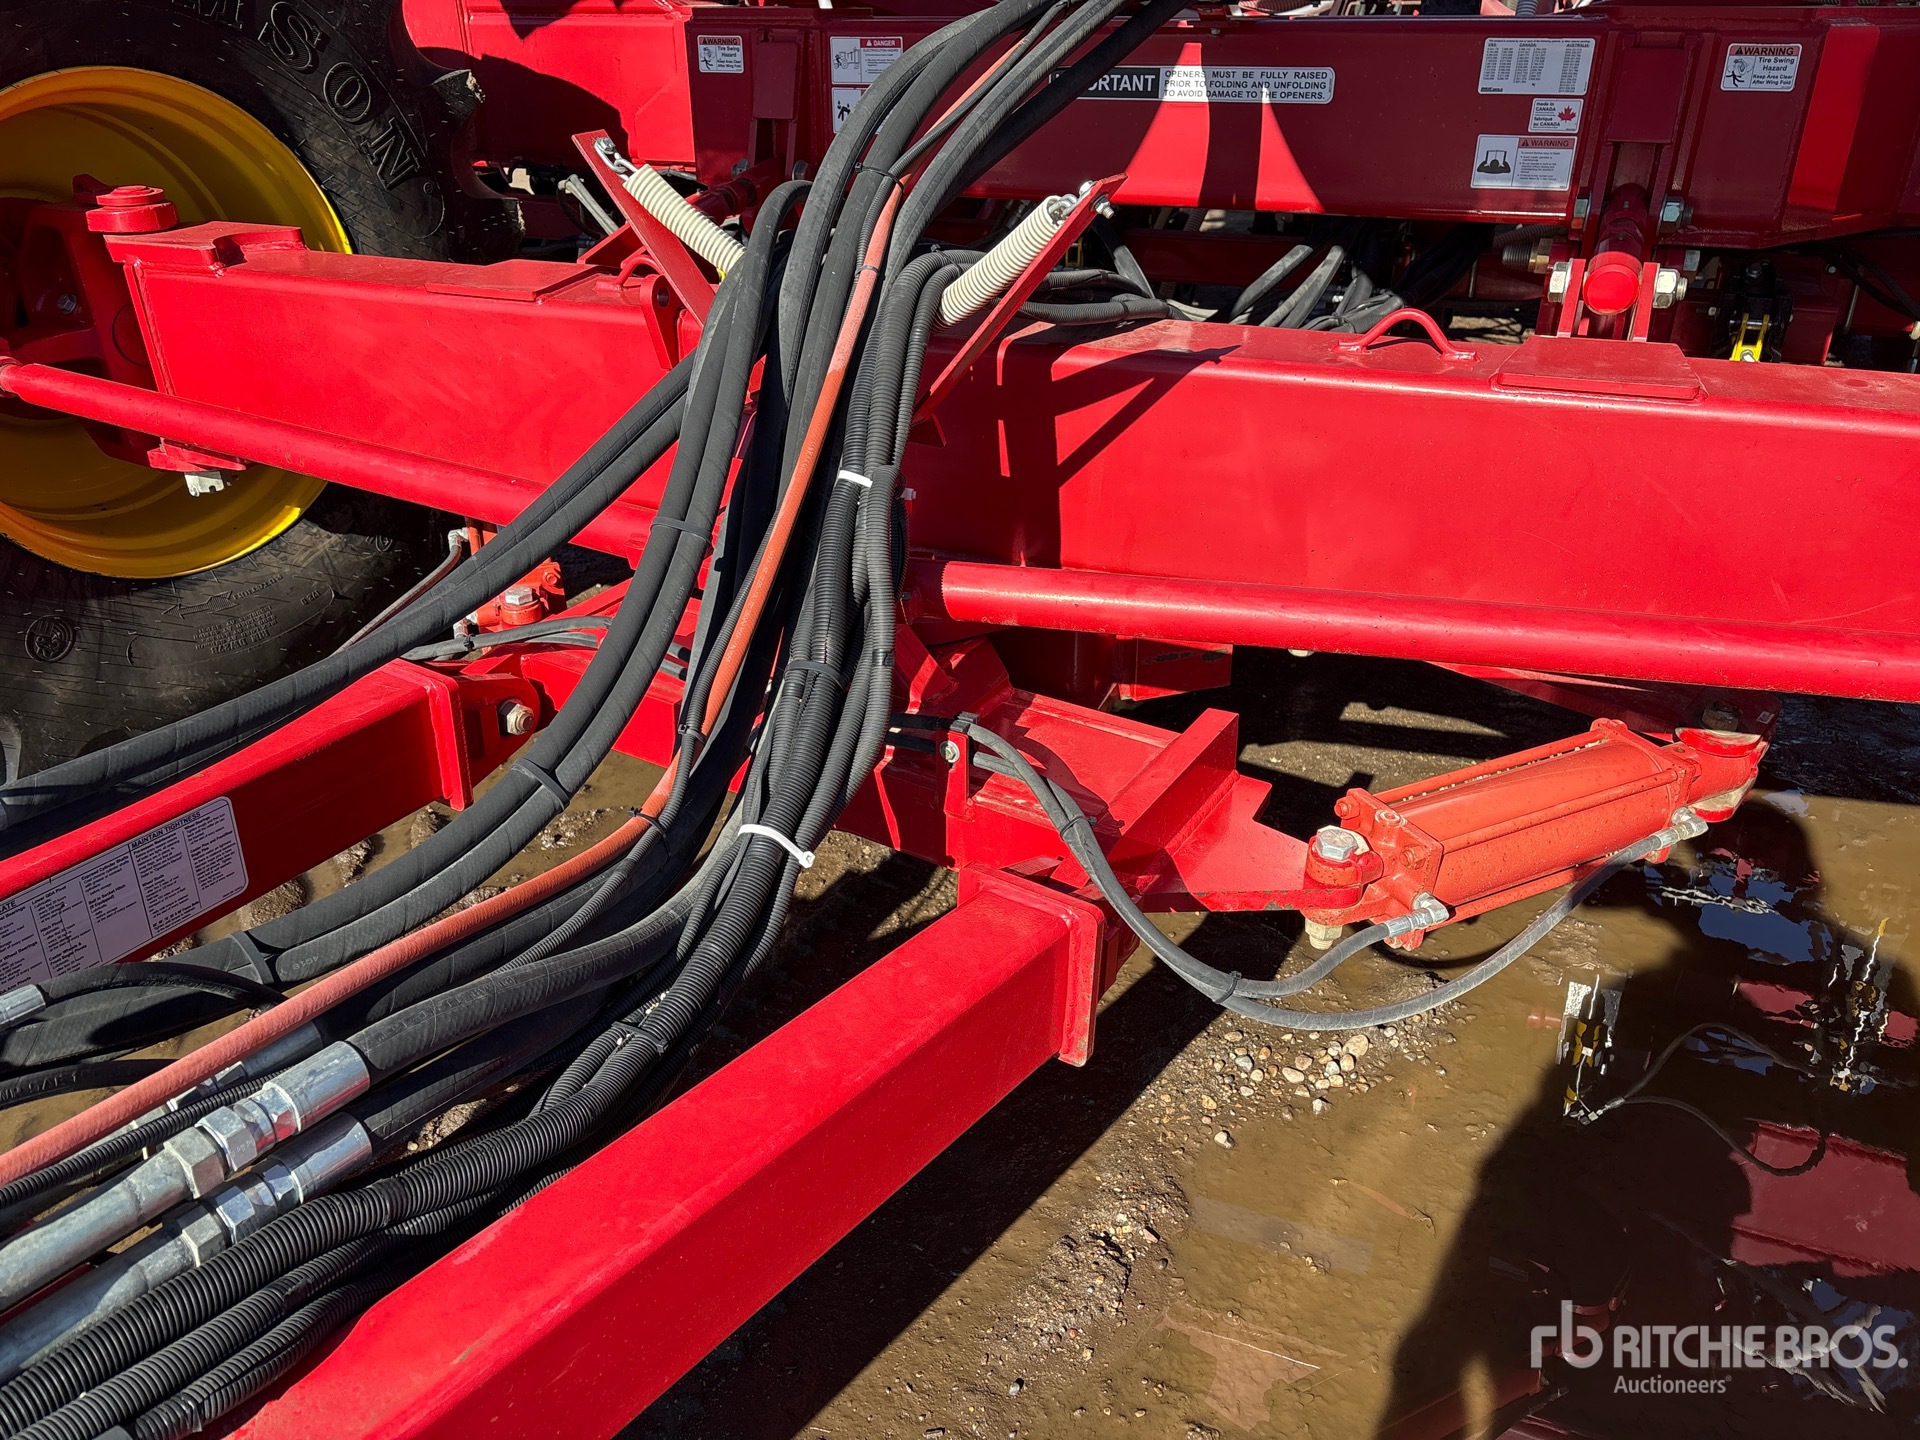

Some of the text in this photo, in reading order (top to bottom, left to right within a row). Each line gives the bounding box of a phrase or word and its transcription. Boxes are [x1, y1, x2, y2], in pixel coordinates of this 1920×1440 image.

[1744, 47, 1794, 55] WARNING
[1165, 70, 1206, 78] OPENERS
[1260, 71, 1288, 79] FULLY
[1294, 71, 1328, 79] RAISED
[1209, 80, 1248, 88] FOLDING
[1274, 81, 1326, 89] UNFOLDING
[1164, 89, 1175, 97] TO
[1206, 90, 1243, 98] DAMAGE
[1279, 91, 1325, 99] OPENERS.
[130, 828, 163, 848] MAINTAIN
[164, 811, 201, 832] TIGHTNESS
